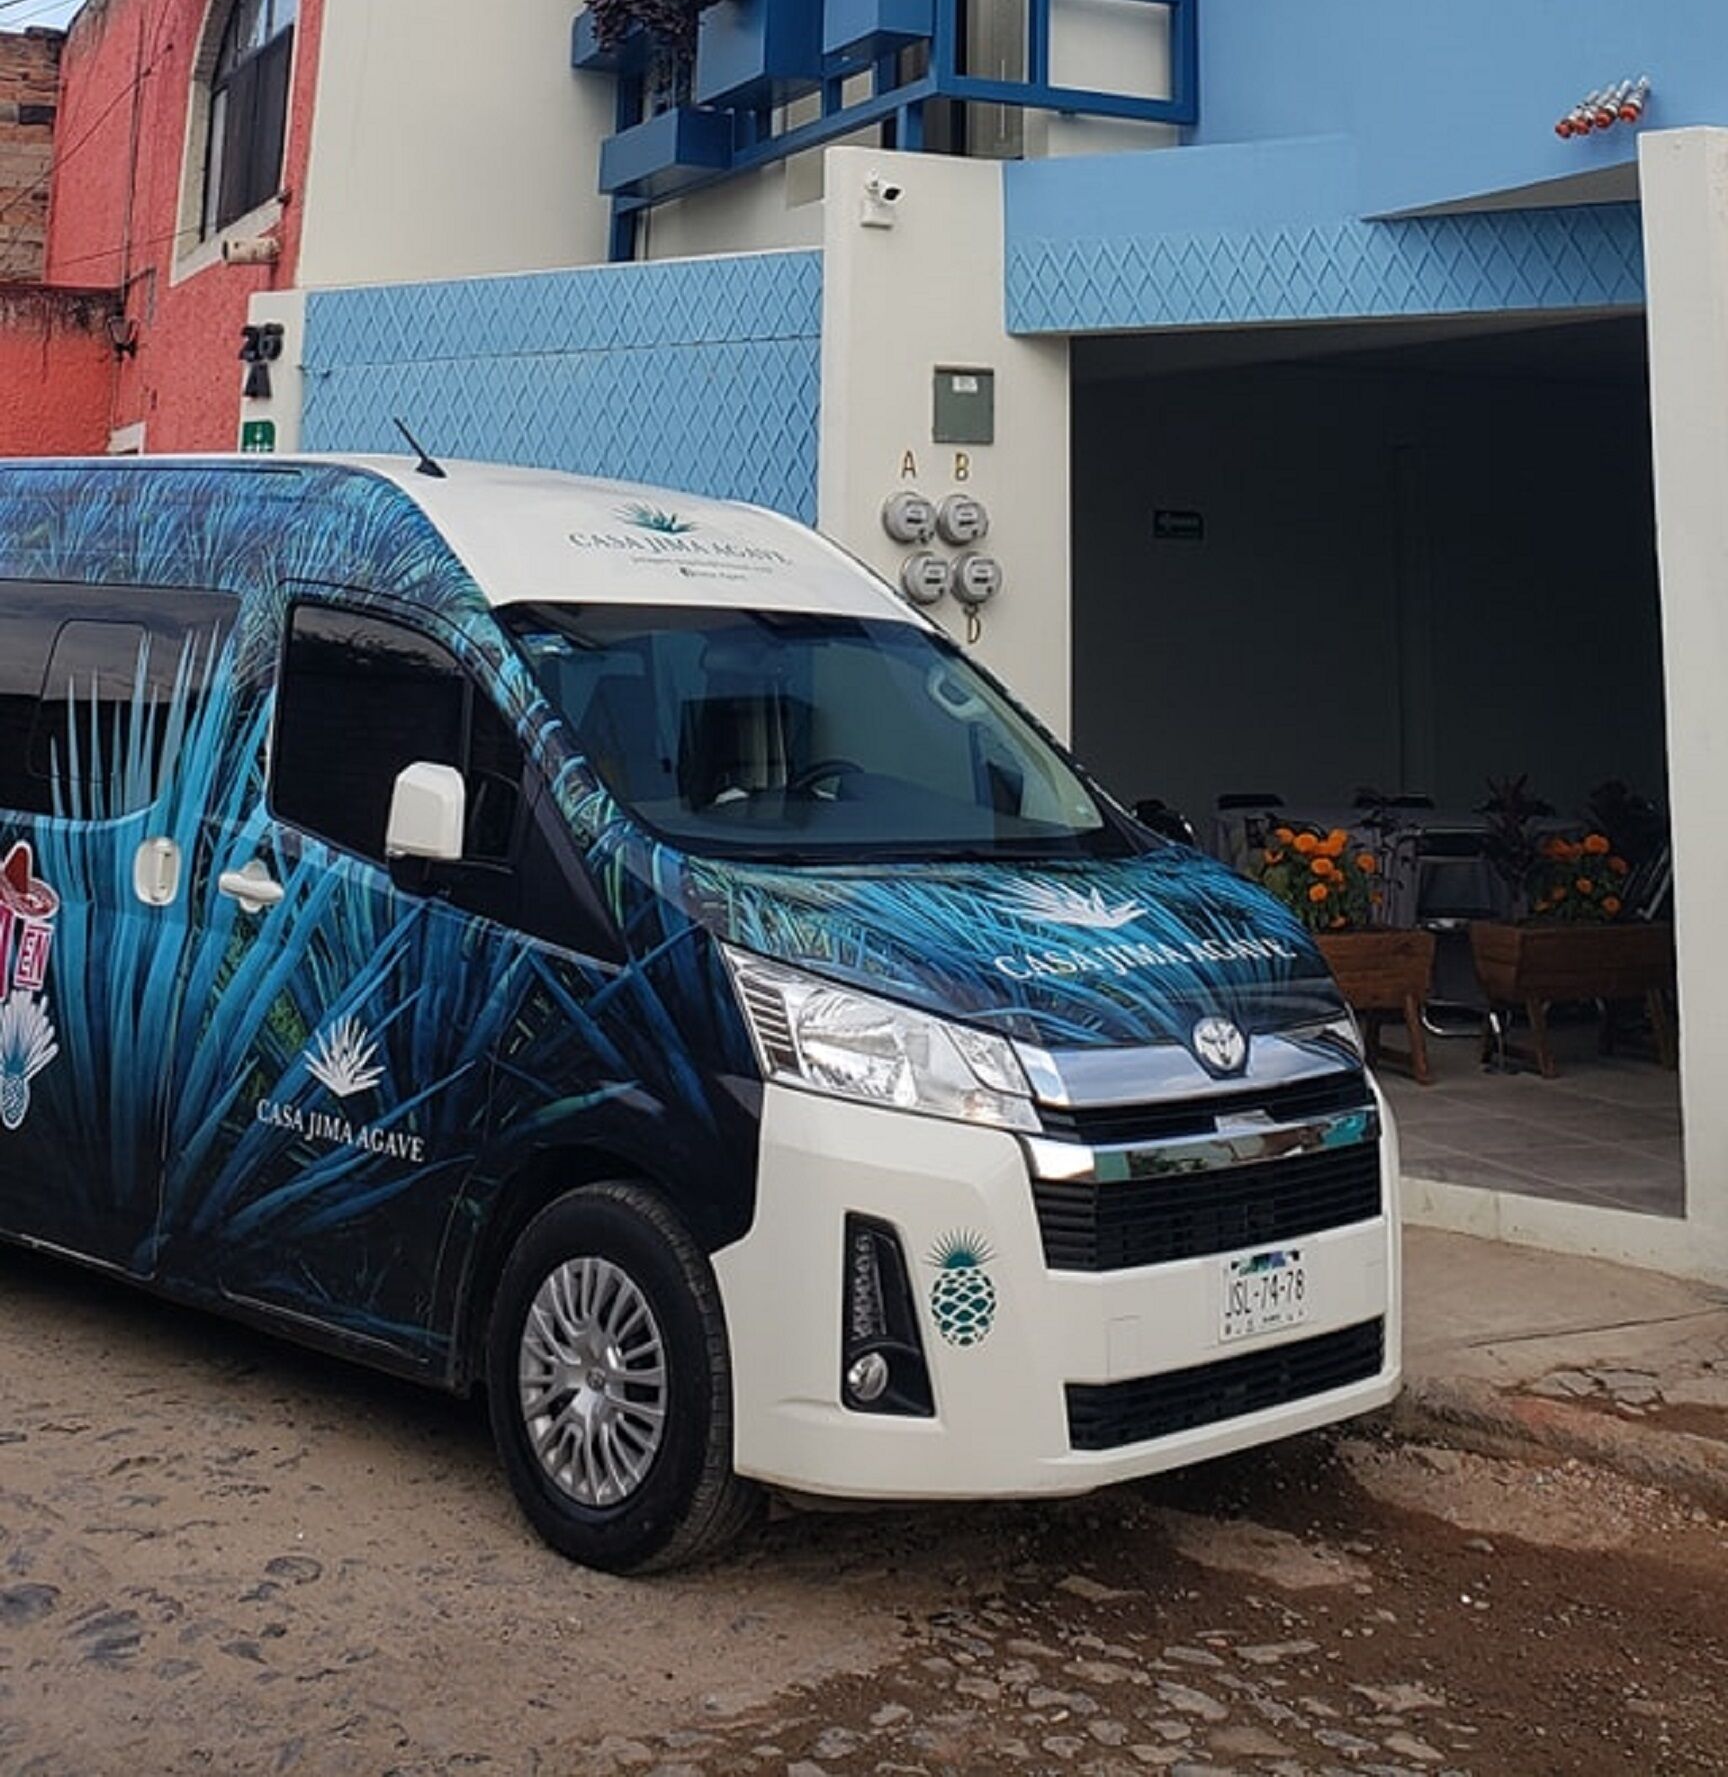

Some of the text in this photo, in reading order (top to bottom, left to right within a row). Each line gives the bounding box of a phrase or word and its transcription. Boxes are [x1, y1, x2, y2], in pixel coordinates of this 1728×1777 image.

[901, 450, 970, 481] A B
[568, 532, 645, 552] CASA
[644, 535, 710, 555] JIMA
[712, 541, 793, 566] AGAVE
[965, 614, 981, 644] D
[995, 937, 1297, 981] CASA JIMA AGAVE
[256, 1098, 426, 1163] CASA JIMA AGAVE
